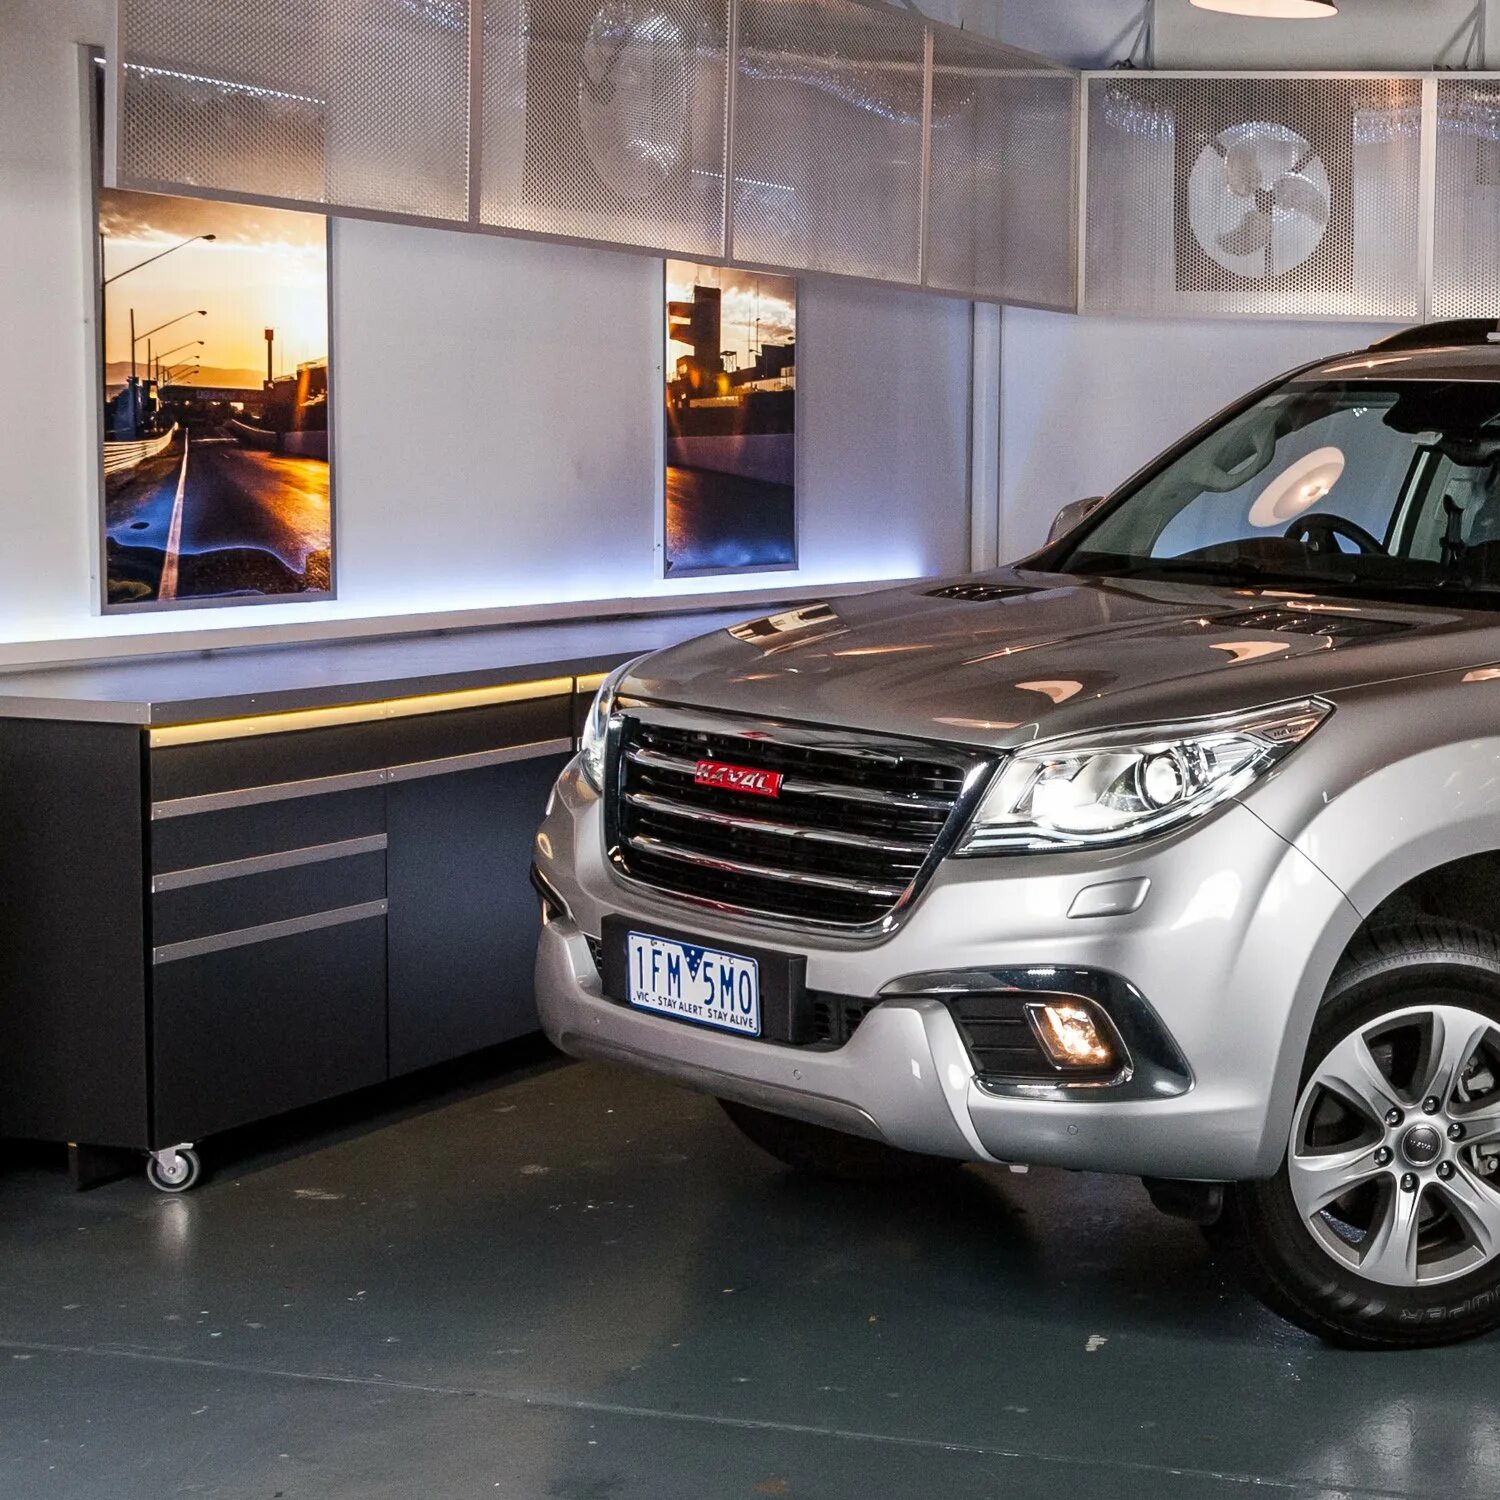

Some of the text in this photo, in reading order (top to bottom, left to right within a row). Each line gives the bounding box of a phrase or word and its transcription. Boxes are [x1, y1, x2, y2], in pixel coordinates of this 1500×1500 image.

[696, 763, 773, 794] HAVAL
[637, 946, 681, 998] 1FM
[636, 991, 650, 1002] VIC
[658, 996, 677, 1010] STAY
[678, 1003, 703, 1016] ALERT
[708, 1008, 728, 1022] STAY
[730, 1014, 753, 1028] ALIVE
